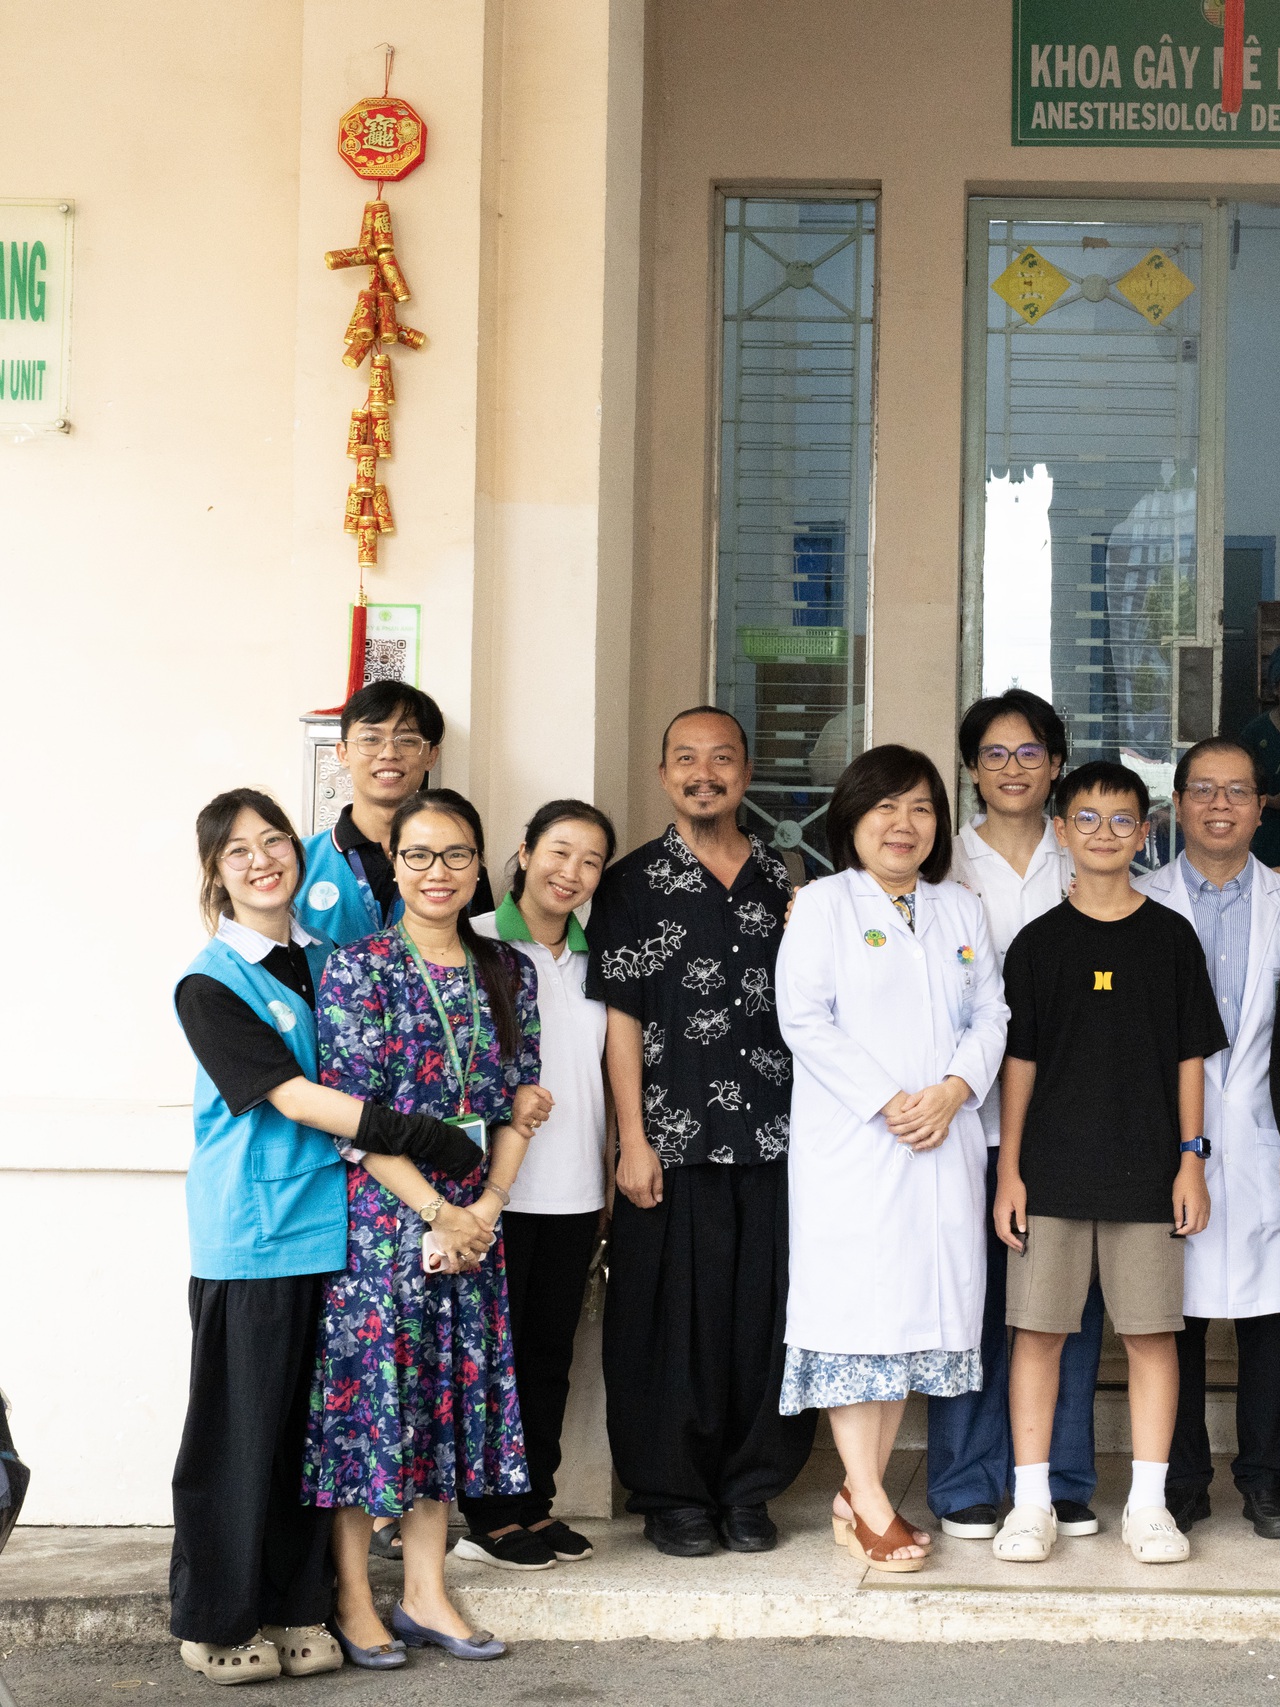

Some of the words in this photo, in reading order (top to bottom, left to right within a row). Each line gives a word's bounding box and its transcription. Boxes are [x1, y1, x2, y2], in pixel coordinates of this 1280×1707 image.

[1030, 44, 1122, 89] KHOA
[1133, 33, 1201, 90] GÂY
[1030, 101, 1241, 131] ANESTHESIOLOGY
[10, 359, 46, 401] UNIT
